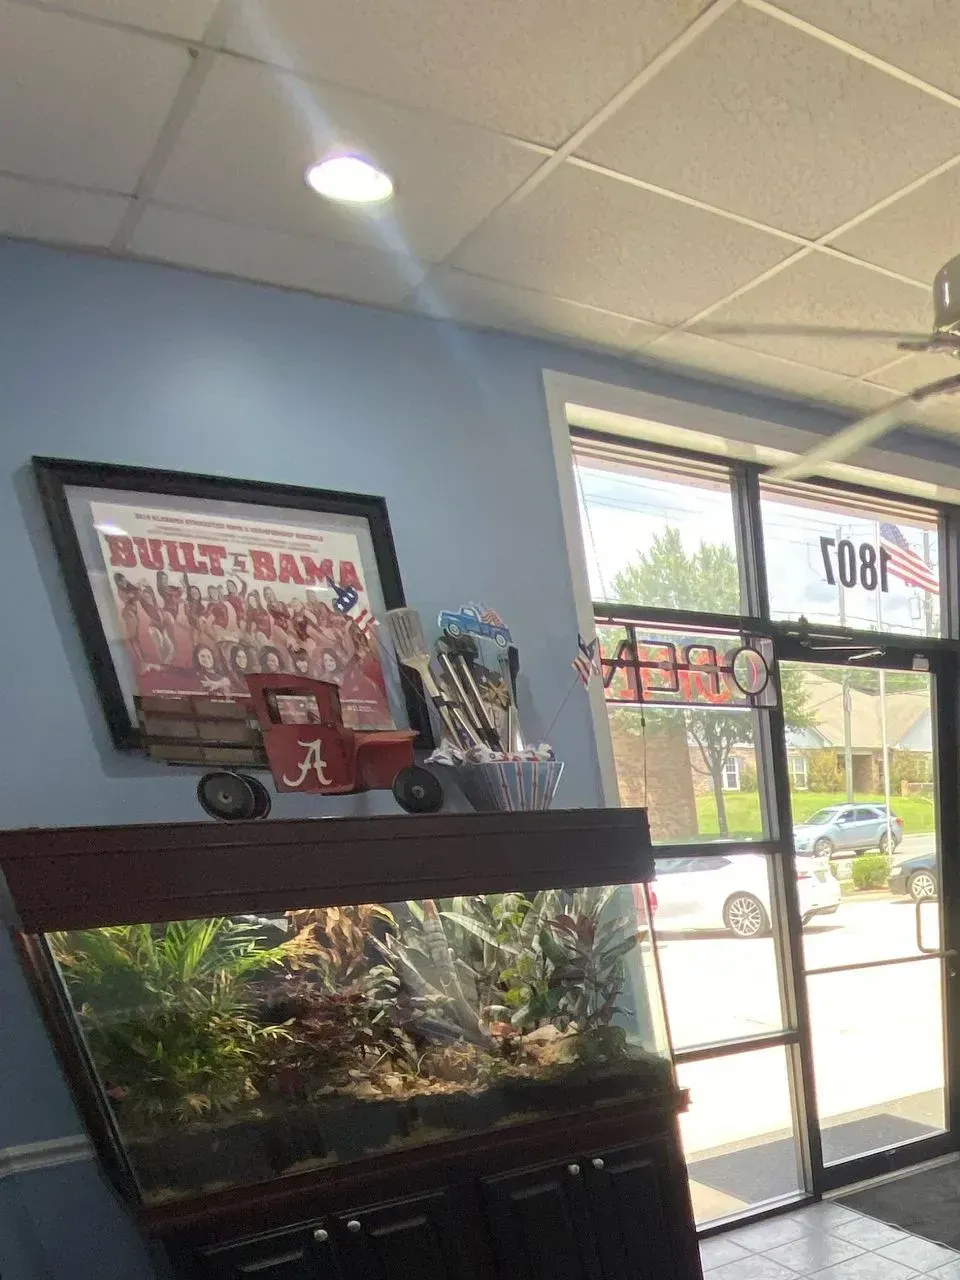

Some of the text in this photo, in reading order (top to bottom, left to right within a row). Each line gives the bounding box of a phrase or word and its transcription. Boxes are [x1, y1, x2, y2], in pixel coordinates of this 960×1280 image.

[103, 534, 227, 577] BUILT
[248, 549, 363, 592] BAMA
[282, 738, 333, 787] A
